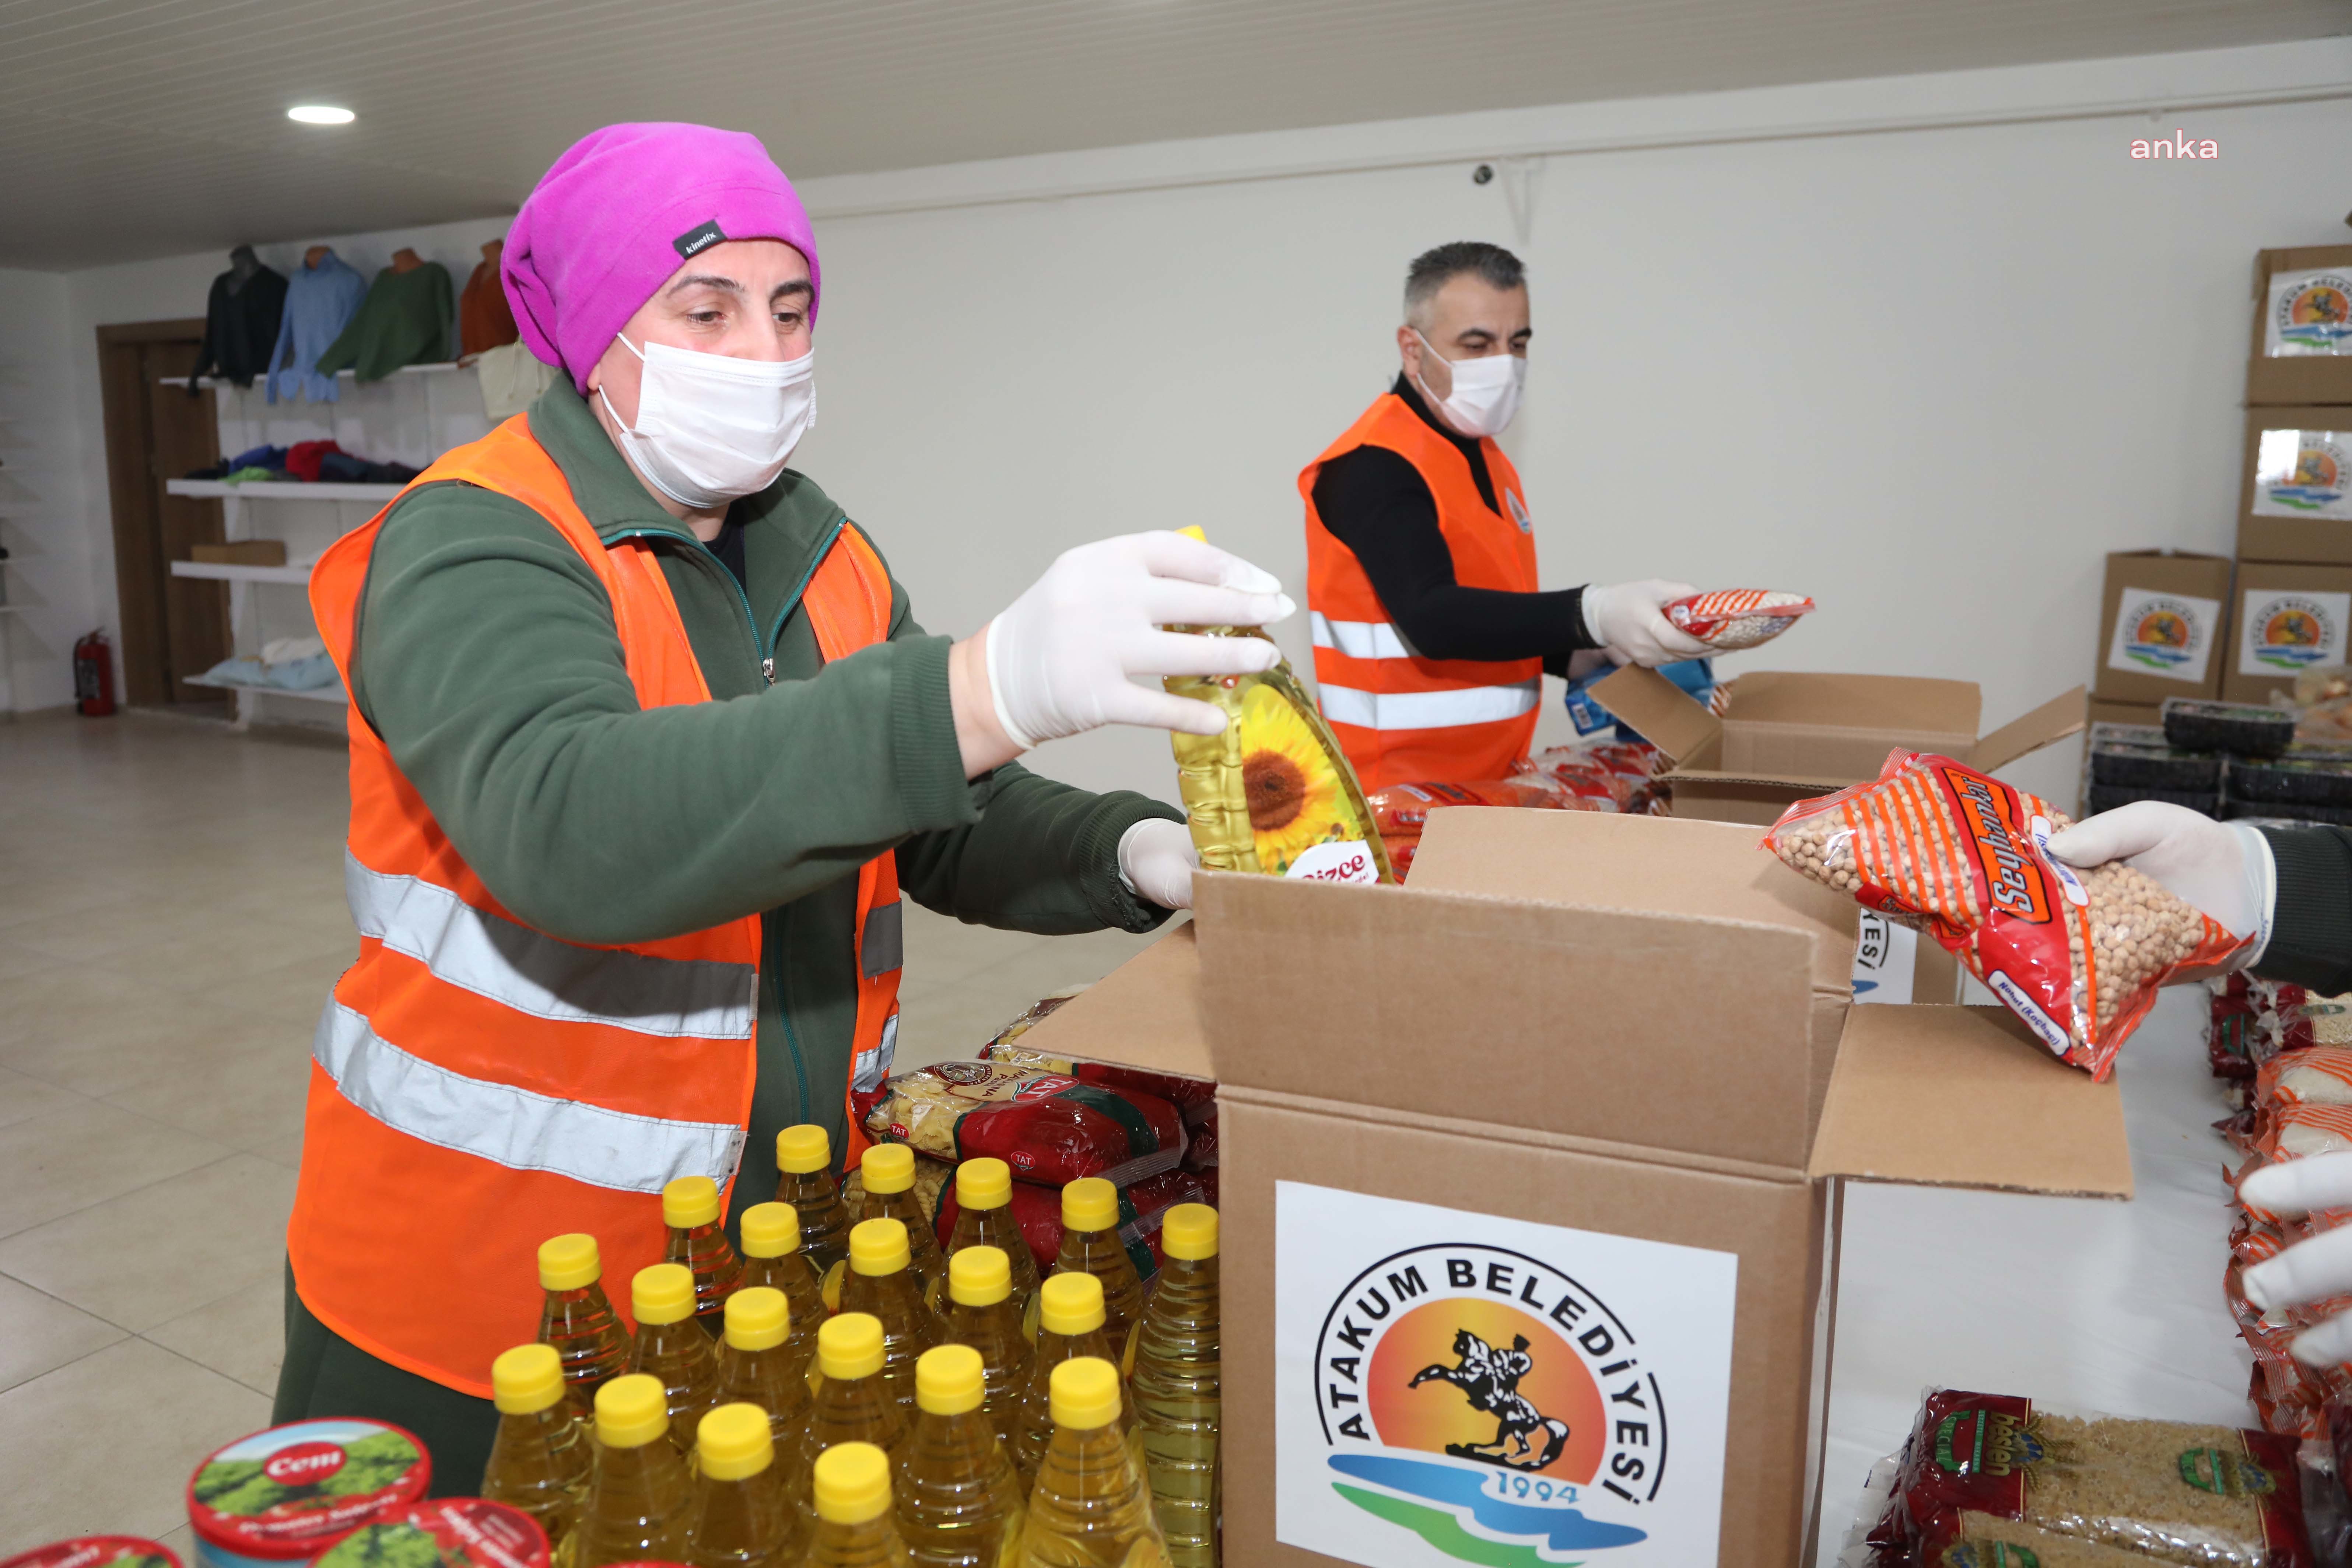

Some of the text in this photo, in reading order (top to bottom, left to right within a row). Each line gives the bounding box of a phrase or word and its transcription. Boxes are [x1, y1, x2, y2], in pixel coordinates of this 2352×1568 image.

[686, 231, 716, 254] kinetix
[1961, 776, 2034, 913] Seyhanlar
[1302, 855, 1365, 880] izce
[1999, 982, 2024, 1007] Nohut
[1026, 1078, 1073, 1097] TAT
[892, 1125, 906, 1136] TAT
[1016, 1154, 1031, 1165] TAT
[1330, 1259, 1649, 1505] ATAKUM BELEDİYESİ
[1936, 1416, 1956, 1462] SPECIAL
[267, 1450, 342, 1476] Cem
[1497, 1471, 1580, 1504] 1994
